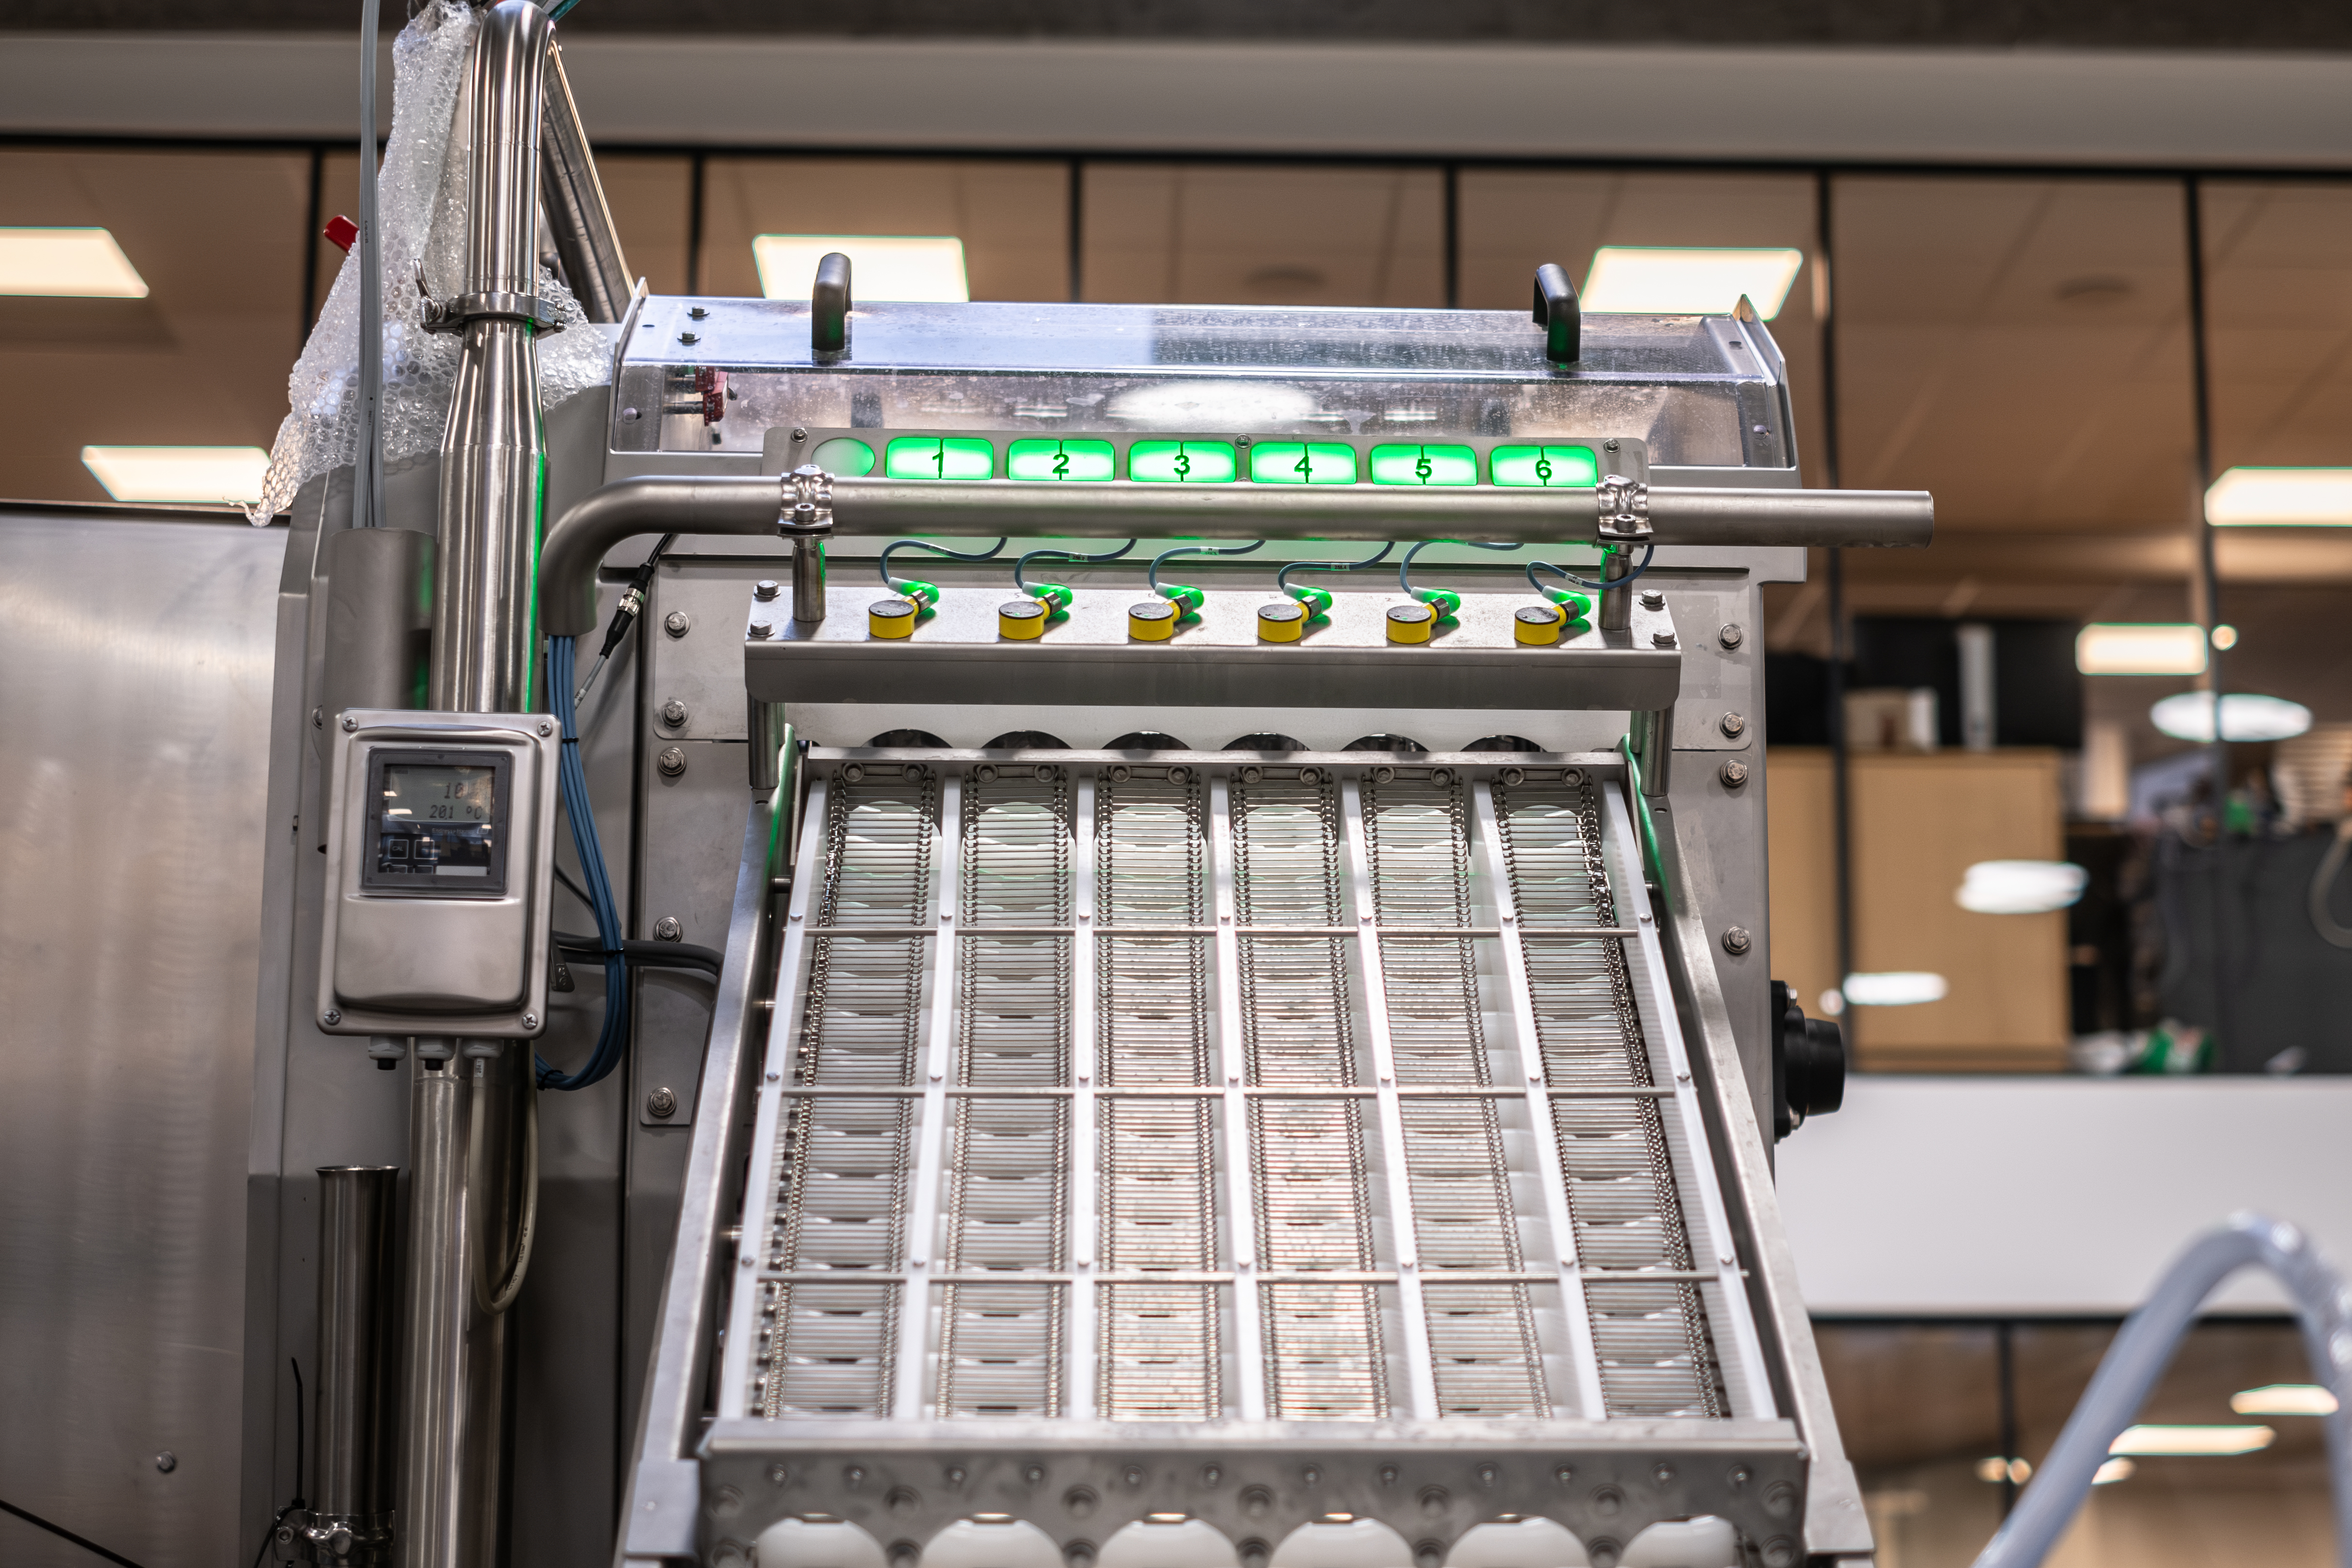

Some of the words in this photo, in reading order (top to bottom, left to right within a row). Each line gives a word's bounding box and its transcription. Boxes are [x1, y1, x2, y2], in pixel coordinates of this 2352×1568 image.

[932, 452, 944, 472] 1
[1052, 454, 1069, 474] 2
[1174, 455, 1191, 474] 3
[1294, 456, 1312, 477] 4
[1415, 458, 1432, 478] 5
[1535, 460, 1552, 479] 6
[444, 782, 464, 799] 10
